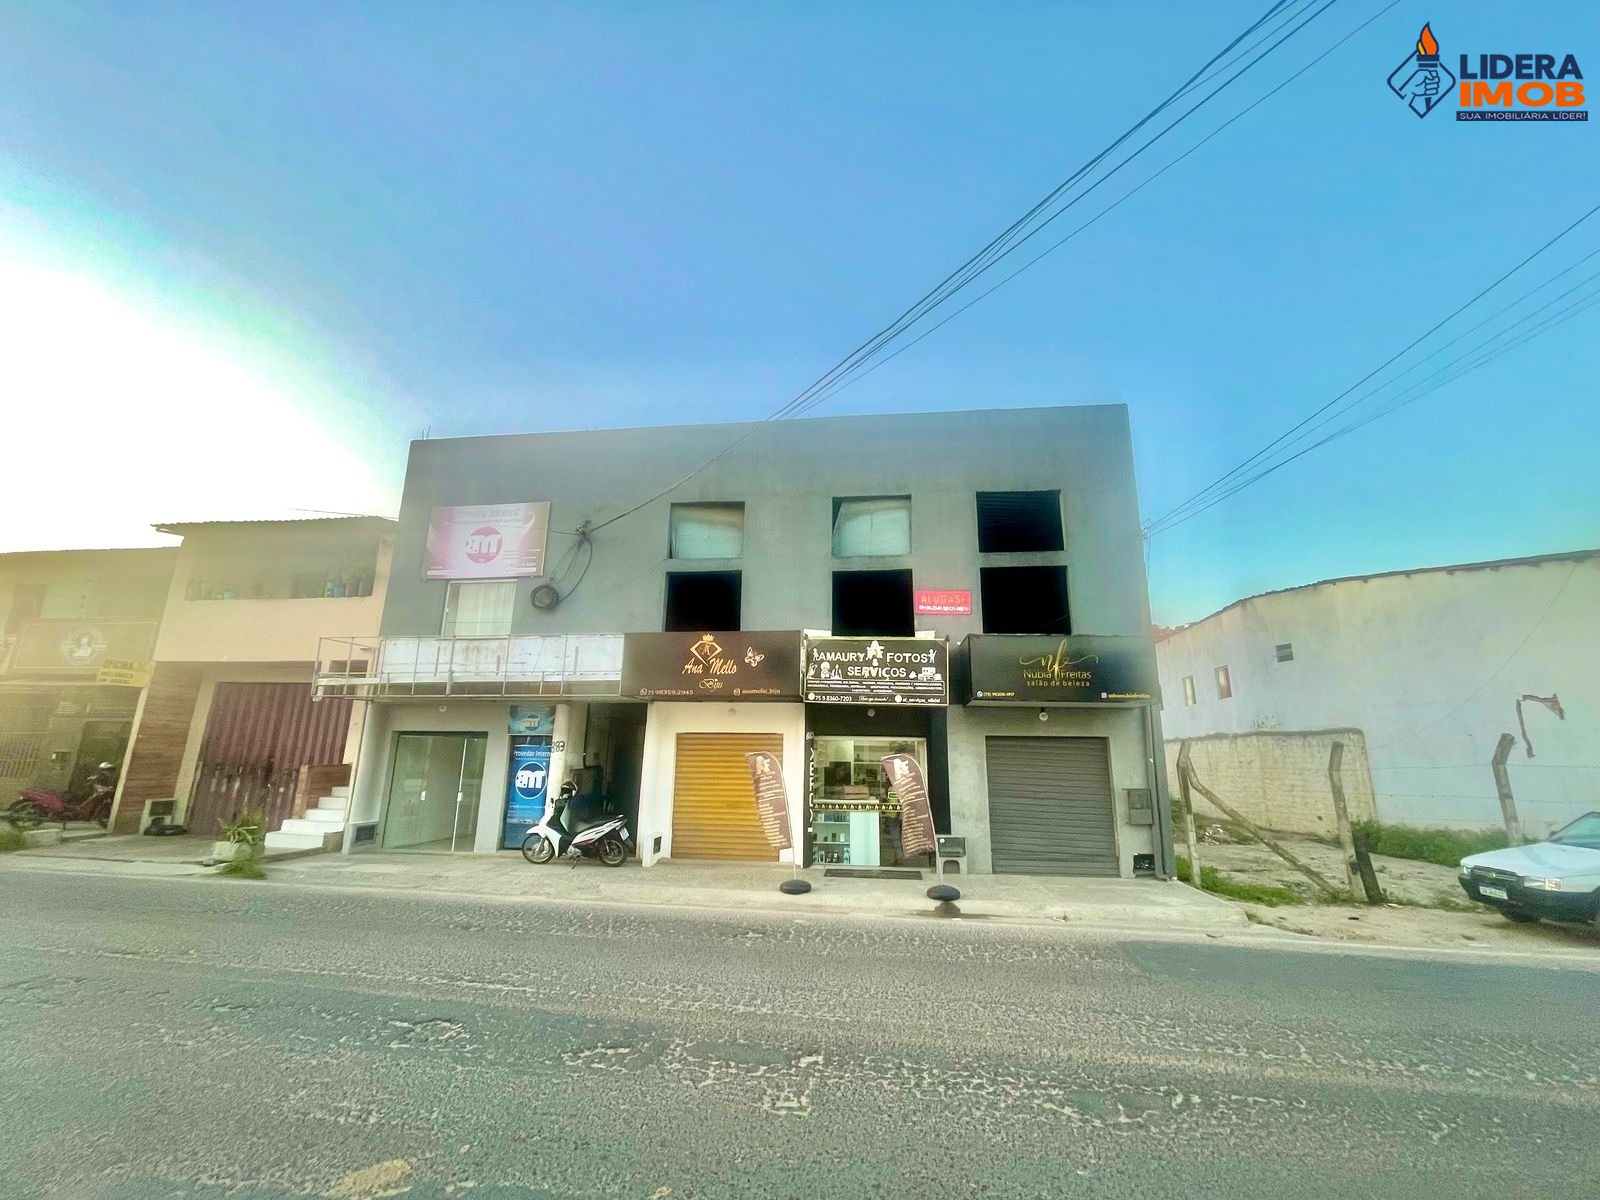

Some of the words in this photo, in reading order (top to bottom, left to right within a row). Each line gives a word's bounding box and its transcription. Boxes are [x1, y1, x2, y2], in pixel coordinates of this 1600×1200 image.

[818, 652, 865, 662] AMAURY
[886, 653, 929, 663] FOTOS
[682, 658, 703, 674] Ana
[709, 658, 737, 674] Mello
[847, 666, 906, 680] SERVIÇOS
[1024, 668, 1052, 679] Núbia
[1061, 670, 1092, 679] Freitas
